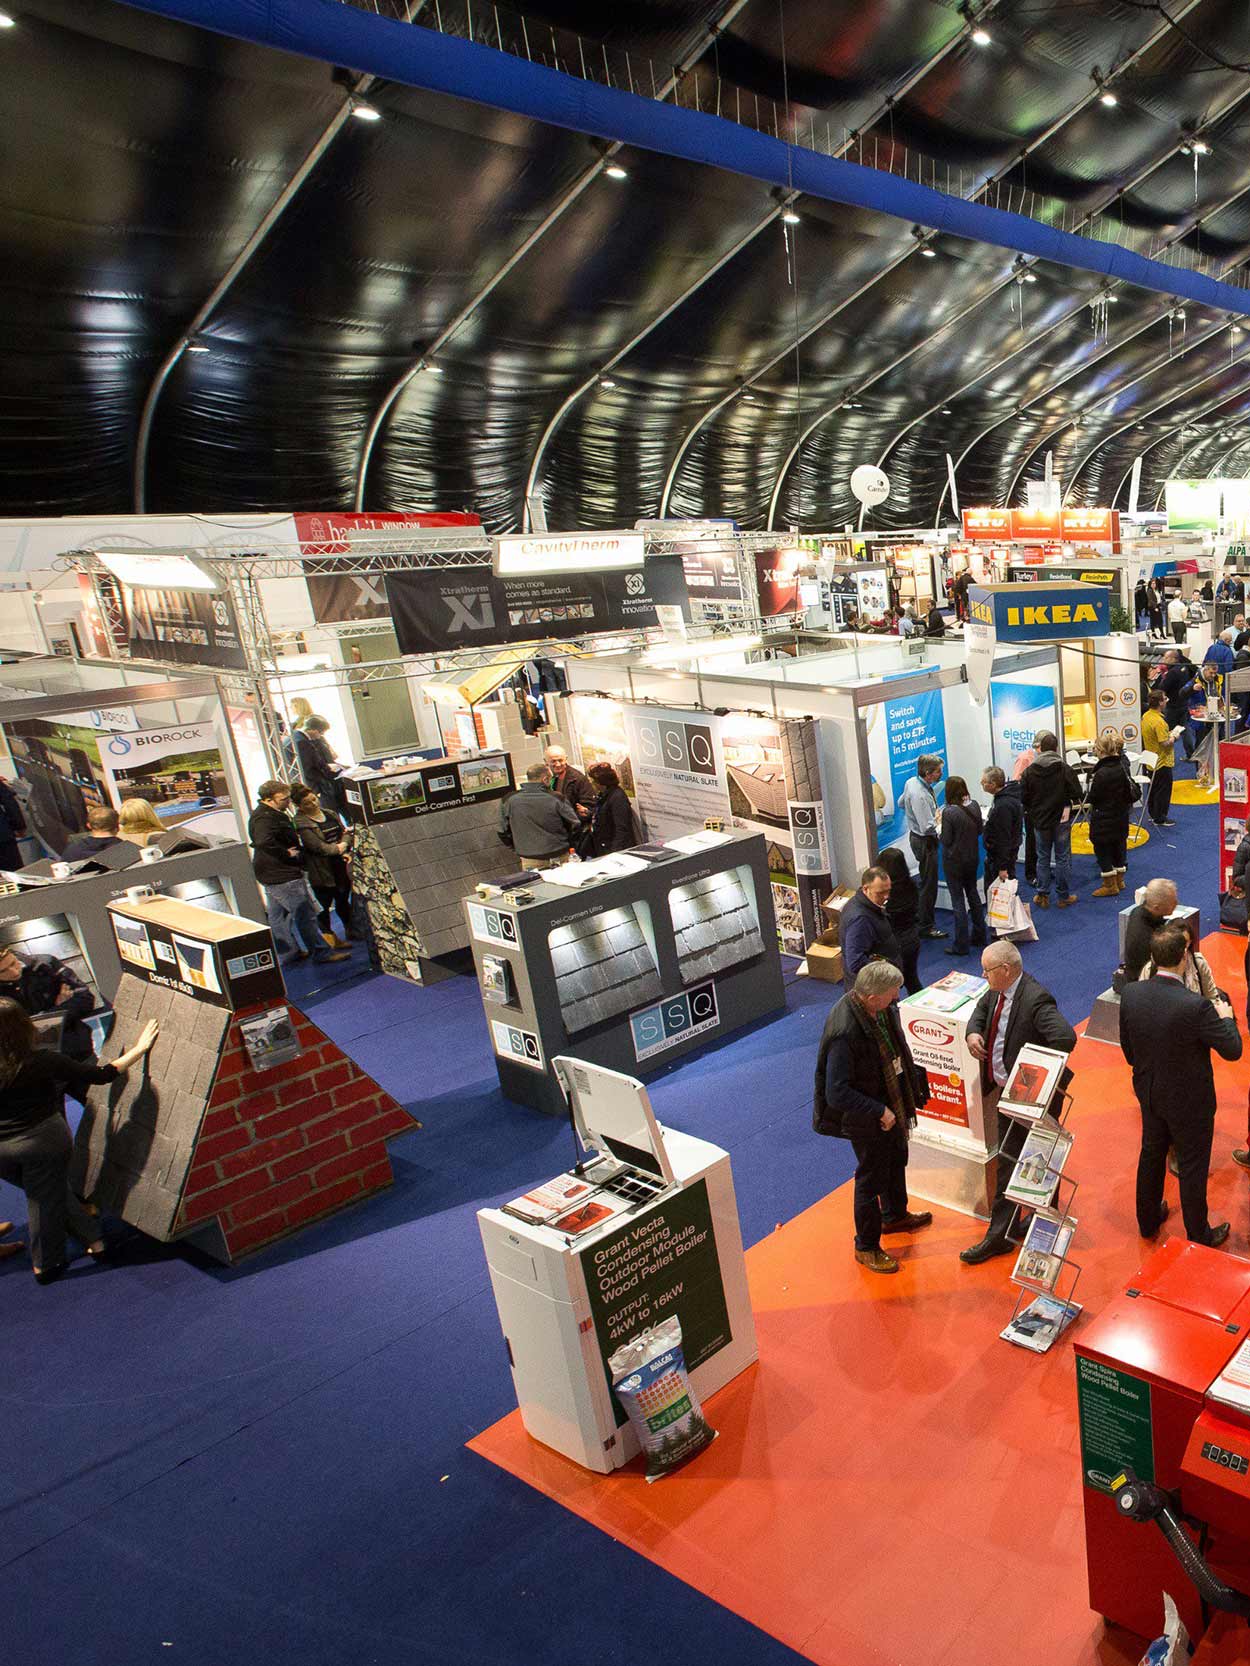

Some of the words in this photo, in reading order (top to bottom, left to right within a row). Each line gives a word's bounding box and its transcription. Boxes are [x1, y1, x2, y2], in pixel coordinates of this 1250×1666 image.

[521, 539, 620, 556] CavityTherm
[440, 584, 490, 596] Xtratherm
[503, 582, 526, 590] When
[505, 590, 531, 599] comes
[441, 593, 497, 633] Xi
[970, 600, 993, 625] IKEA
[1007, 604, 1098, 626] IKEA
[889, 705, 915, 719] Switch
[891, 720, 905, 731] and
[905, 717, 922, 727] save
[135, 729, 203, 747] BIOROCK
[892, 734, 902, 744] up
[903, 732, 911, 740] to
[1003, 728, 1036, 741] electri
[639, 727, 717, 768] SSQ
[893, 745, 901, 755] in
[901, 743, 907, 752] 5
[907, 736, 937, 751] minutes
[673, 772, 701, 785] NATURAL
[701, 777, 719, 787] SLATE
[415, 798, 462, 814] Del-Carmen
[462, 794, 476, 803] First
[550, 910, 588, 927] Del-Carmen
[639, 992, 714, 1042] SSQ
[674, 1027, 702, 1043] NATURAL
[701, 1019, 719, 1031] SLATE
[913, 1024, 943, 1038] GRANT
[912, 1047, 930, 1058] Grant
[929, 1052, 954, 1064] Oil-fired
[942, 1062, 961, 1073] Boiler
[933, 1082, 964, 1097] boilers.
[936, 1091, 962, 1105] Grant.
[594, 1236, 630, 1264] Grant
[630, 1215, 666, 1241] Vecta
[596, 1226, 671, 1278] Condensing
[599, 1252, 650, 1291] Outdoor
[652, 1224, 696, 1258] Module
[601, 1274, 640, 1304] Wood
[640, 1252, 675, 1279] Pellet
[675, 1229, 708, 1257] Boiler
[606, 1292, 651, 1327] OUTPUT:
[610, 1314, 636, 1340] 4kW
[638, 1307, 651, 1320] to
[653, 1281, 685, 1311] 16kW
[1080, 1357, 1099, 1371] Grant
[1080, 1364, 1120, 1387] Condensing
[1080, 1372, 1101, 1386] Wood
[1100, 1379, 1120, 1393] Pellet
